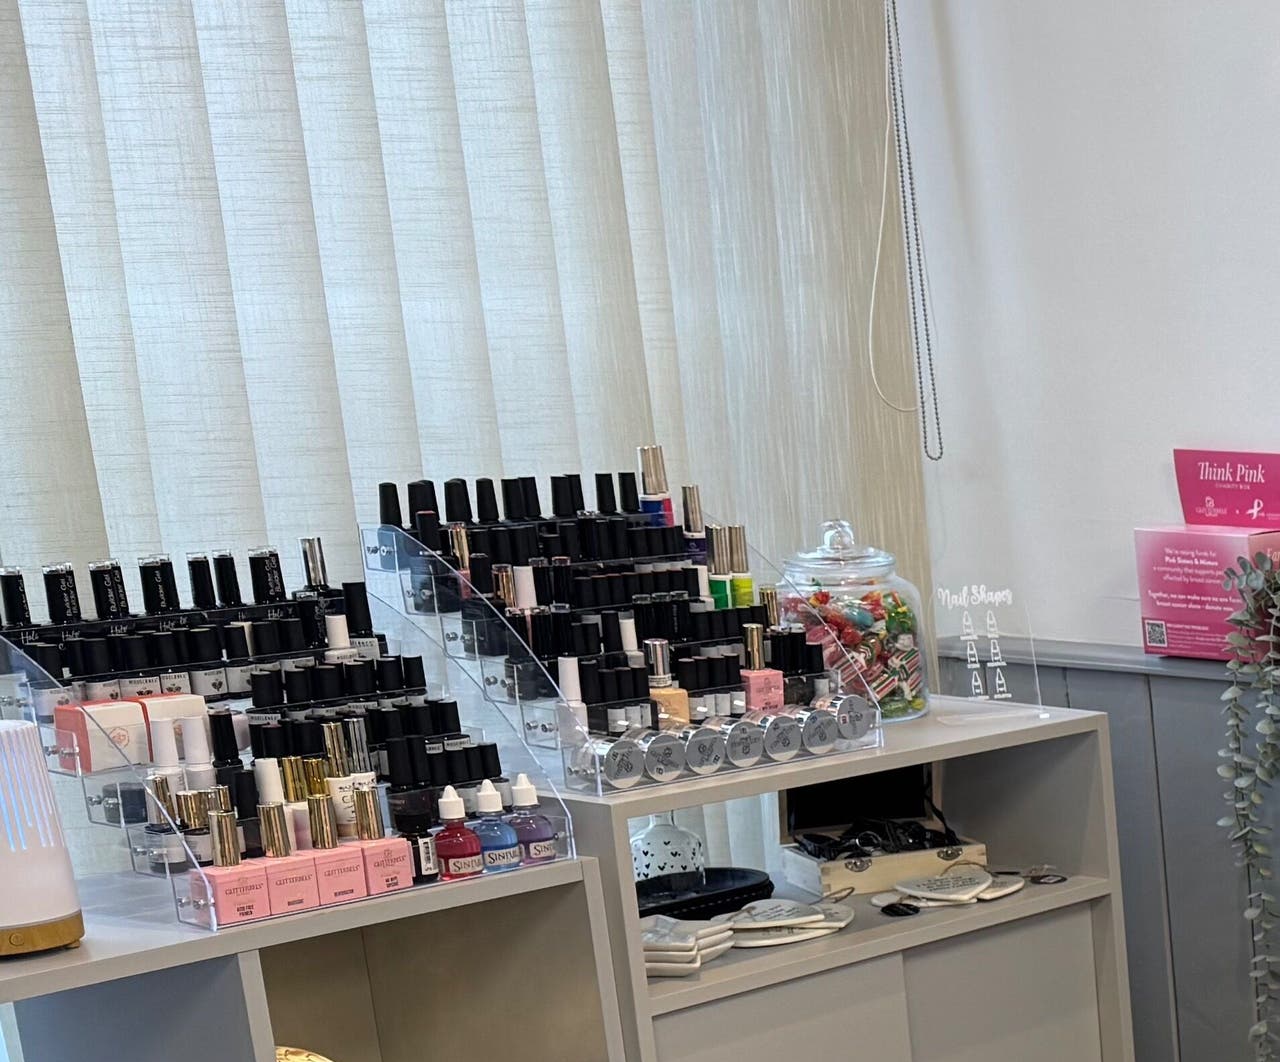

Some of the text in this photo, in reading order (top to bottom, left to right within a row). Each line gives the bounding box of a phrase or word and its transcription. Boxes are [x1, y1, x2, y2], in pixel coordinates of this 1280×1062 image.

[1197, 461, 1265, 483] Think Pink
[937, 584, 1013, 610] Nail Shapes
